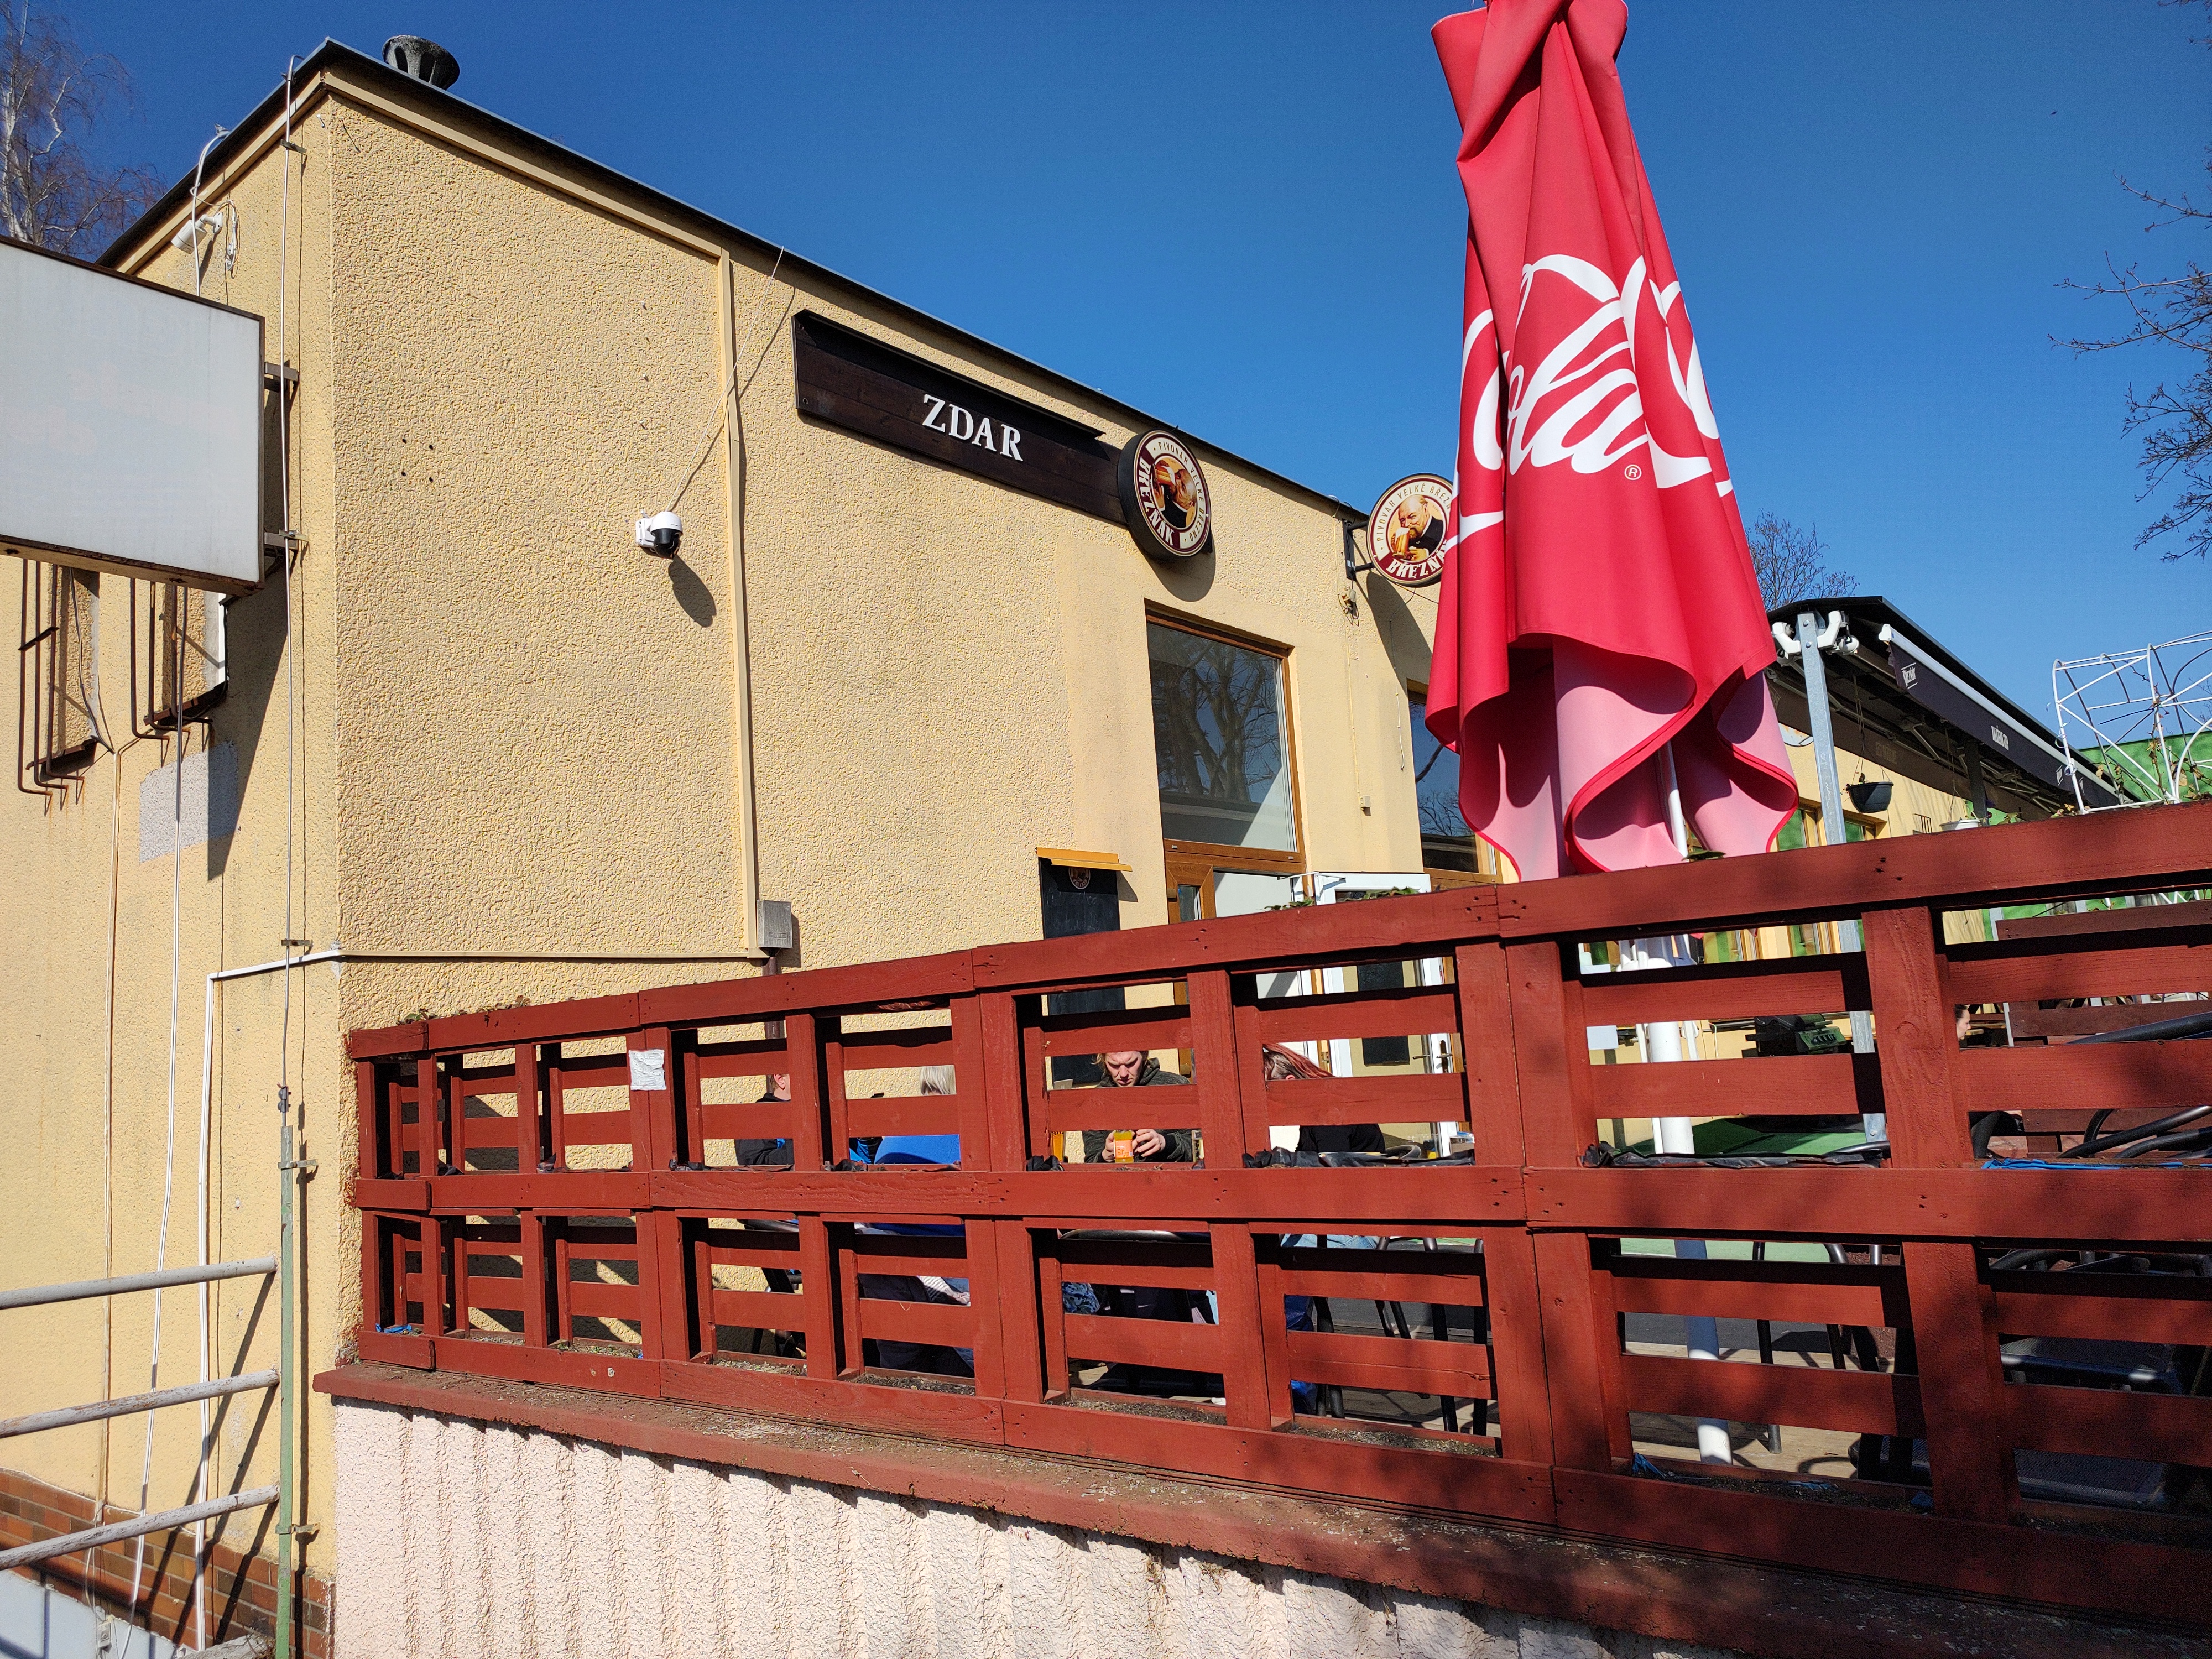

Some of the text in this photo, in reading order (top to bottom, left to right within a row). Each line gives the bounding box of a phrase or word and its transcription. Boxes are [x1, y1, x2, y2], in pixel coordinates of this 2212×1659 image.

[922, 394, 1024, 462] ZDAR
[1158, 441, 1188, 465] PIVOVAR
[1376, 499, 1396, 541] PIVOVAR
[1397, 482, 1426, 499] VELKÉ
[1429, 485, 1452, 510] BŘEZN
